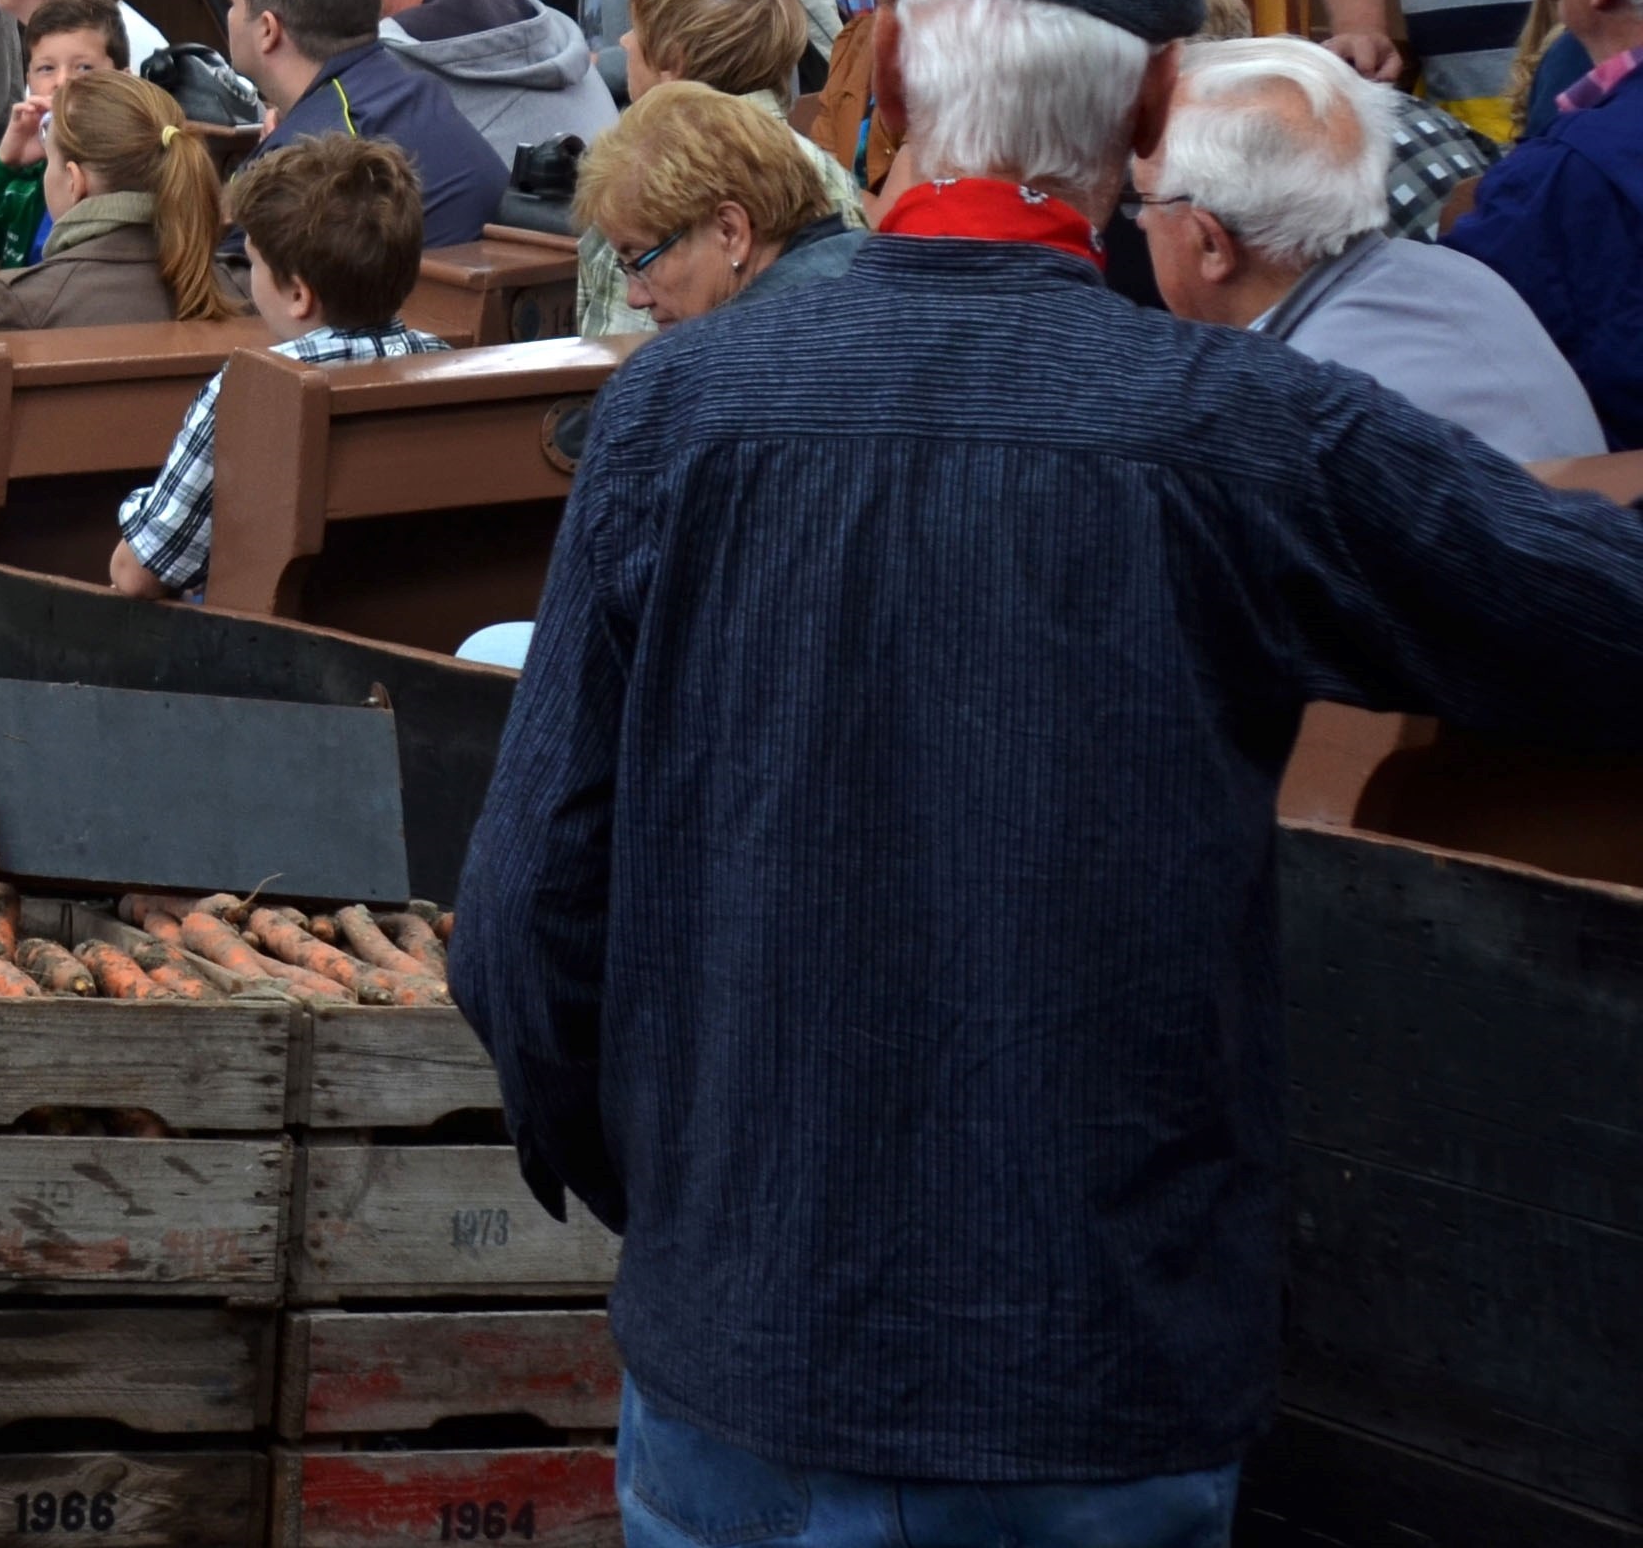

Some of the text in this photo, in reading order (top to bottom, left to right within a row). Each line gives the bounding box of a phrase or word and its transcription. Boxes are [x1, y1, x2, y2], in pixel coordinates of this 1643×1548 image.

[451, 1208, 510, 1247] 1973
[15, 1490, 118, 1534] 1966
[437, 1498, 536, 1542] 1964
